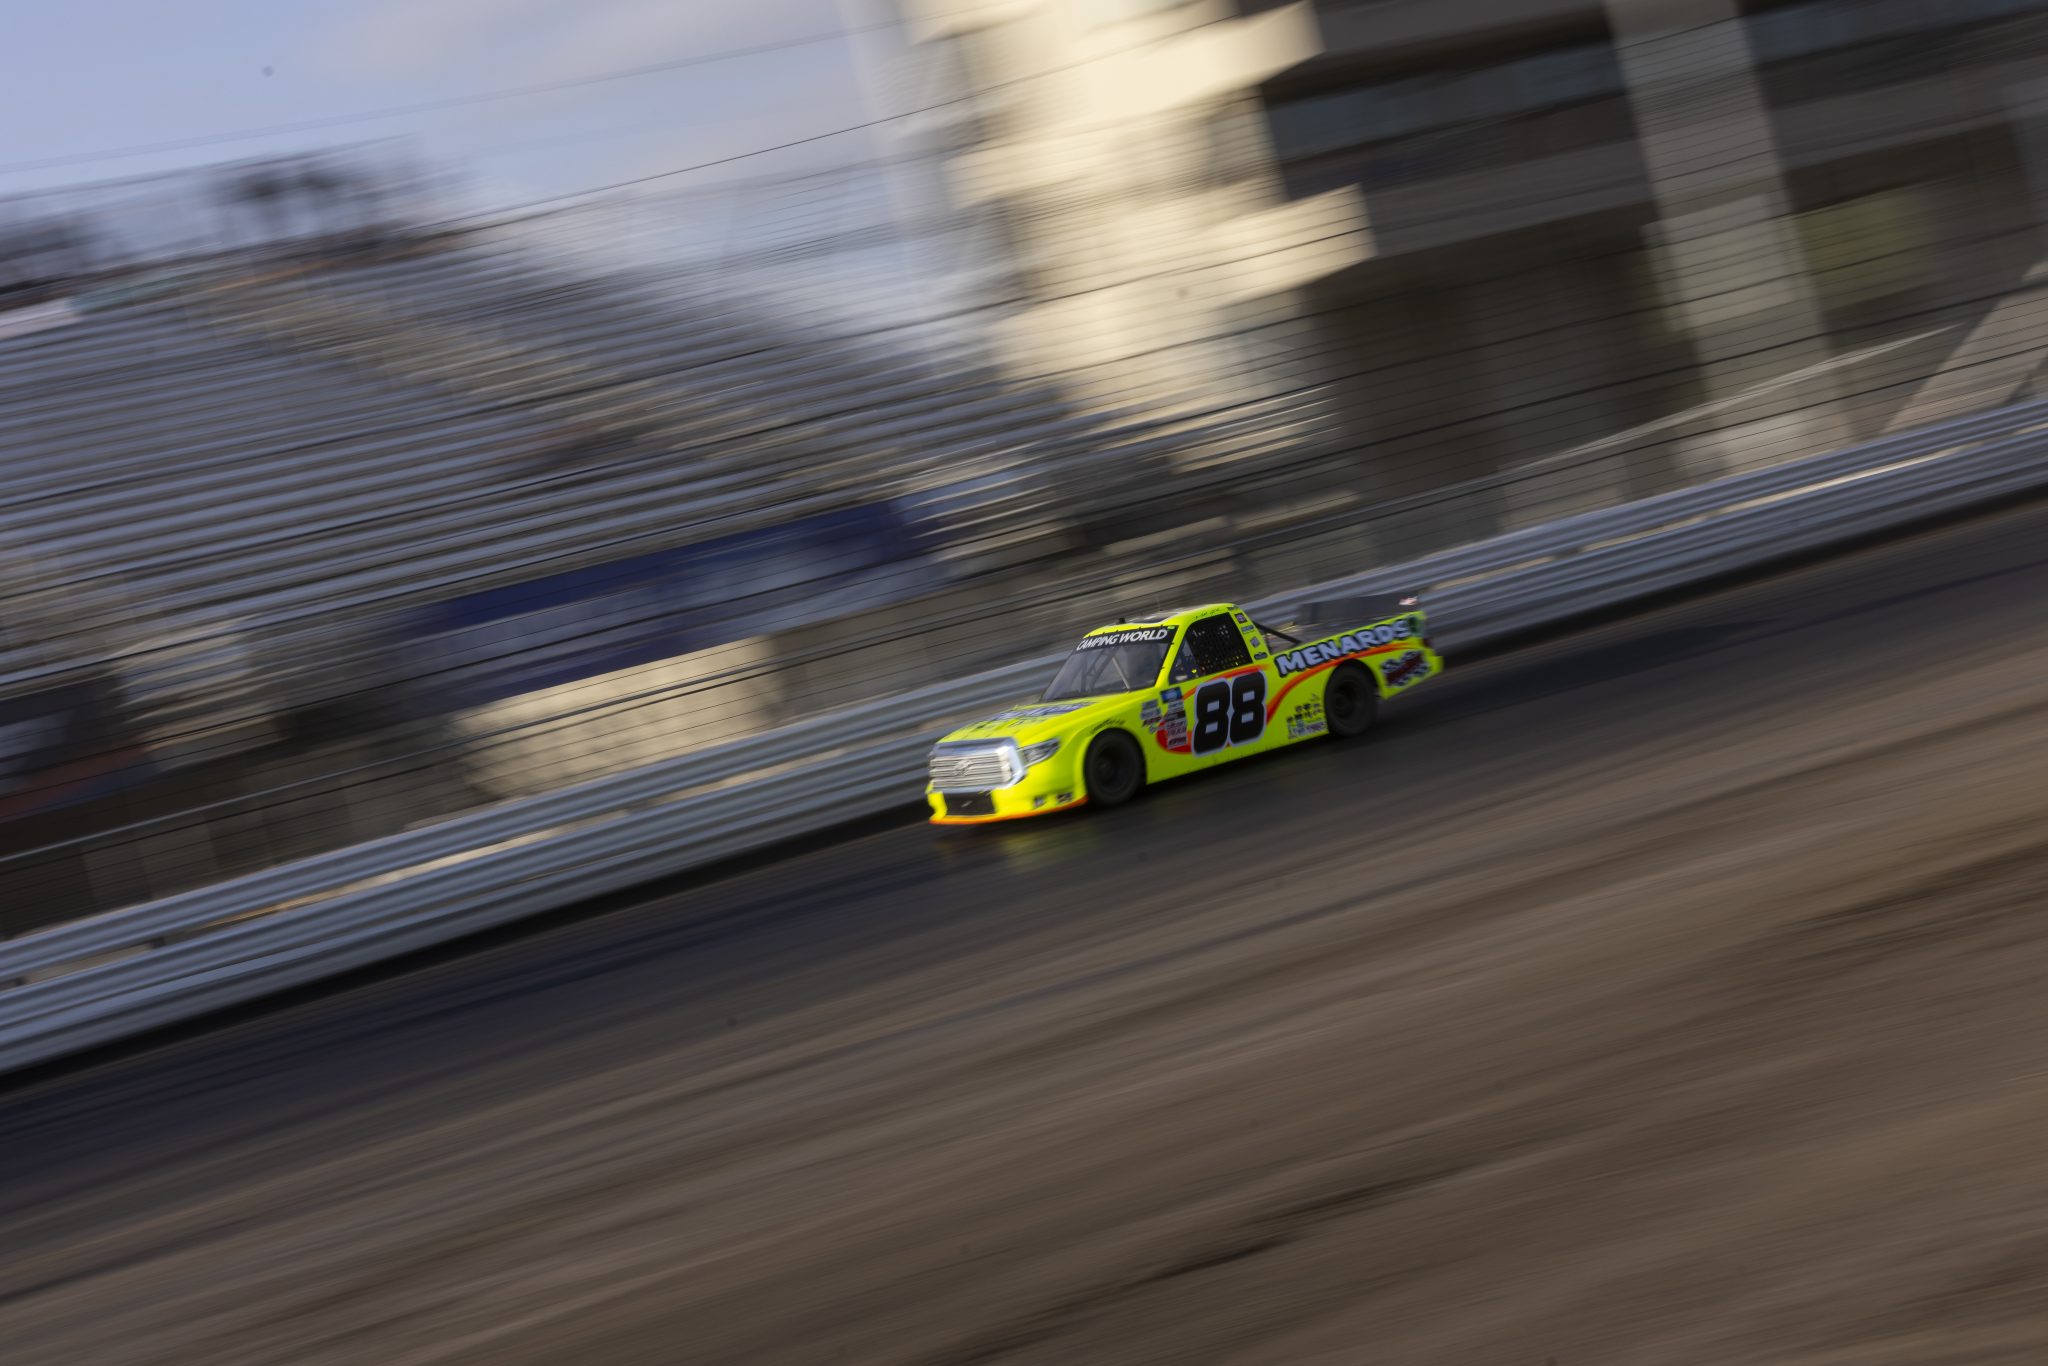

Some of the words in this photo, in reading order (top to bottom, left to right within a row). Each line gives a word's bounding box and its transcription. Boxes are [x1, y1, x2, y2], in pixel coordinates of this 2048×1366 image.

[1076, 633, 1120, 651] CAMPING
[1119, 629, 1168, 643] WORLD
[1274, 618, 1410, 678] MENARDS
[1191, 670, 1267, 758] 88
